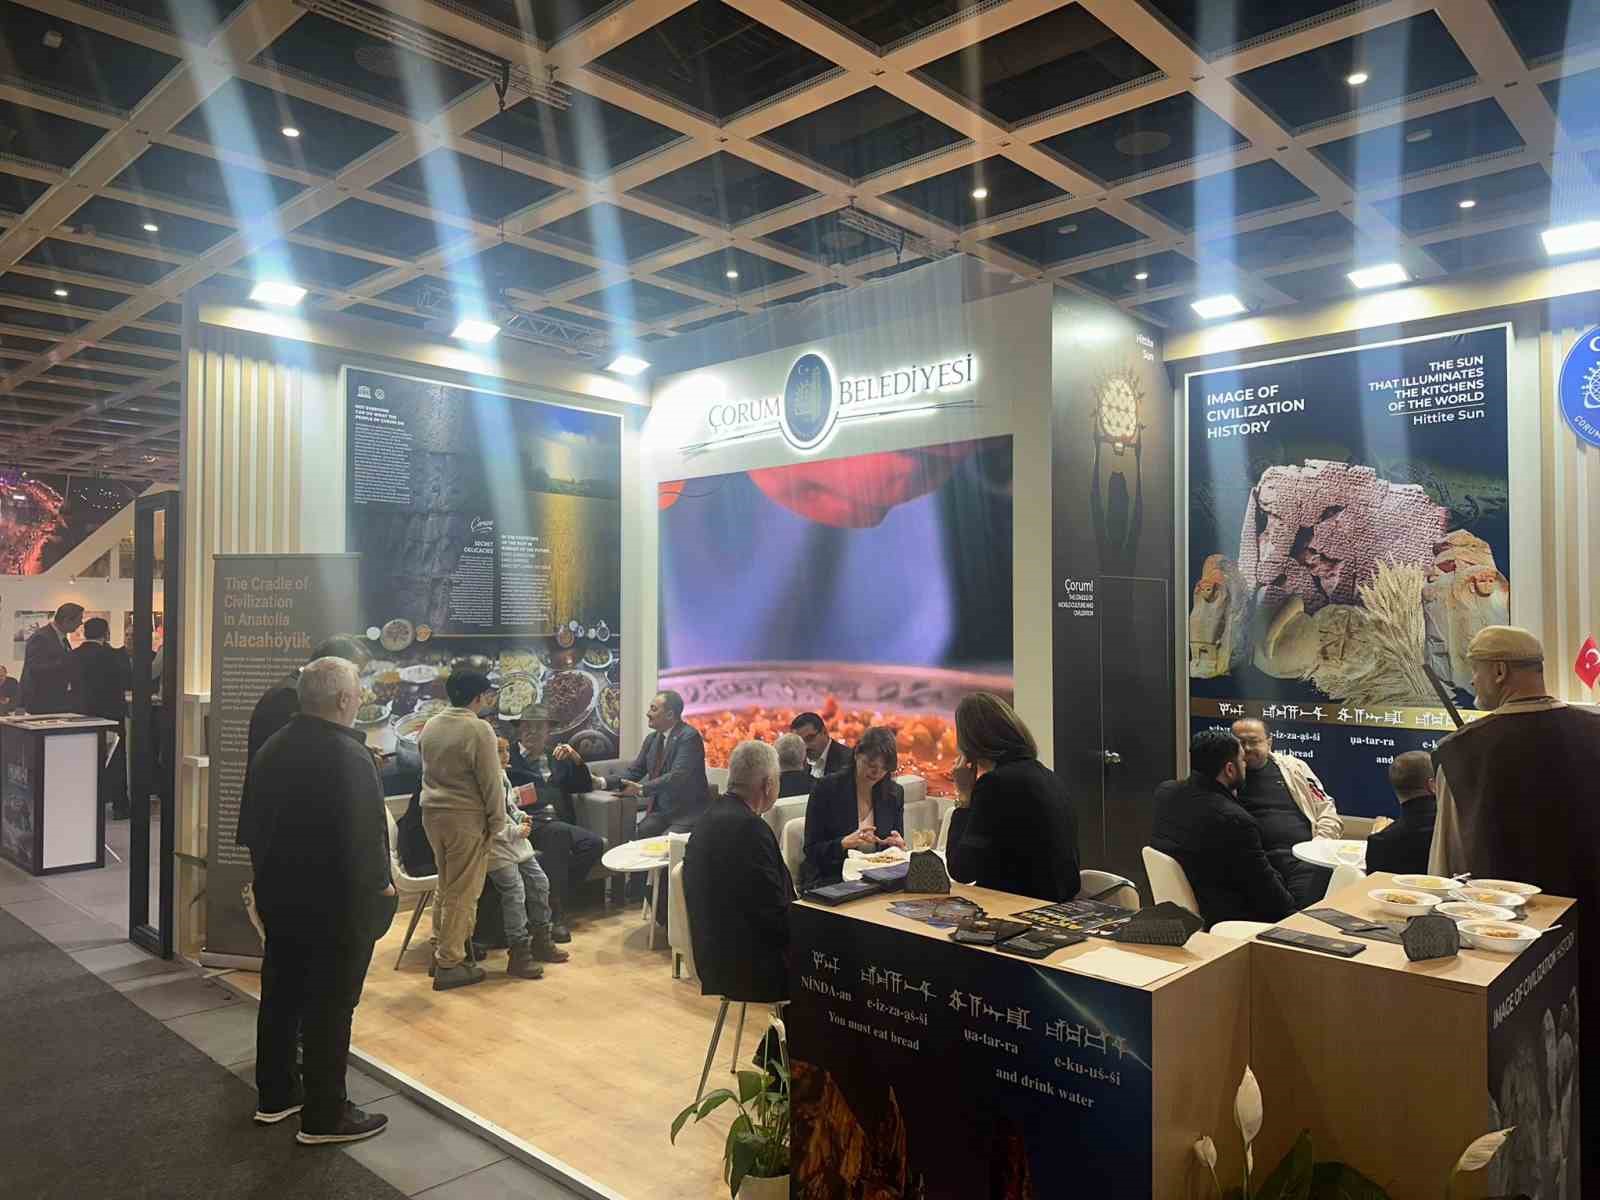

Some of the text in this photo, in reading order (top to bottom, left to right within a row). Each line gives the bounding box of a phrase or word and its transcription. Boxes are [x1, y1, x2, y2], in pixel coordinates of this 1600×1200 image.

[1430, 355, 1483, 371] THE SUN
[1368, 367, 1483, 391] THAT ILLUMINATES
[708, 353, 972, 432] ÇORUM BELEDİYESİ
[1208, 385, 1279, 405] IMAGE OF
[1394, 379, 1484, 399] THE KITCHENS
[1207, 399, 1304, 422] CIVILIZATION
[1388, 392, 1484, 411] OF THE WORLD
[1414, 410, 1484, 425] Hittite Sun
[1208, 420, 1270, 439] HISTORY
[224, 576, 248, 590] The
[251, 576, 293, 590] Cradle
[224, 593, 293, 608] Civilization
[224, 612, 289, 626] in Anatolia
[1376, 756, 1394, 764] and
[828, 1011, 919, 1050] You must eat bread
[996, 1068, 1095, 1108] and drink water
